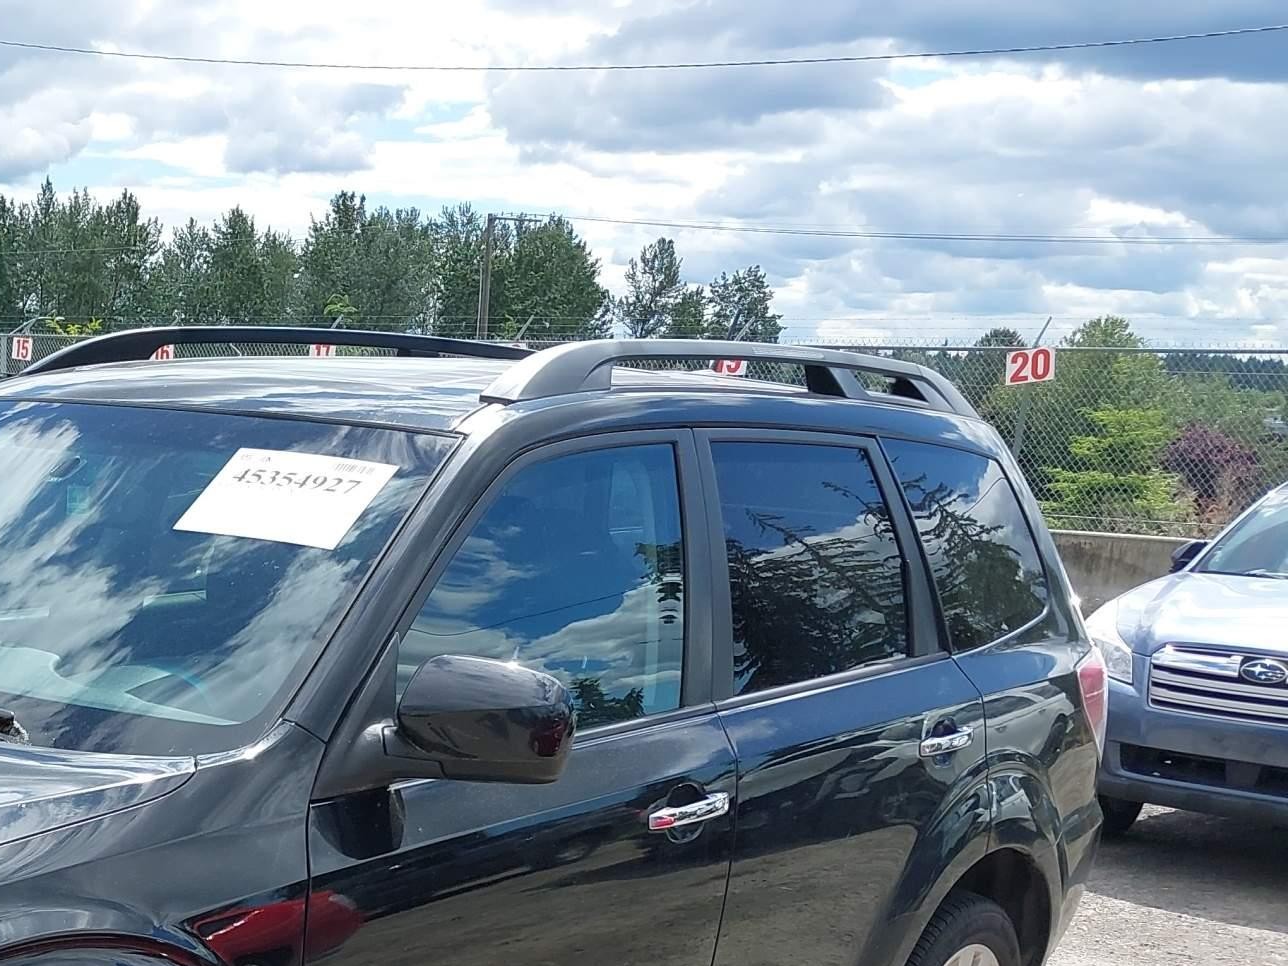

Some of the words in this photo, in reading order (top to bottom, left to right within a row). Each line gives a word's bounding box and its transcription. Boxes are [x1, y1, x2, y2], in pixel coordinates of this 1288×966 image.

[16, 339, 29, 359] 15
[1010, 349, 1050, 383] 20
[232, 468, 363, 494] 45354927
